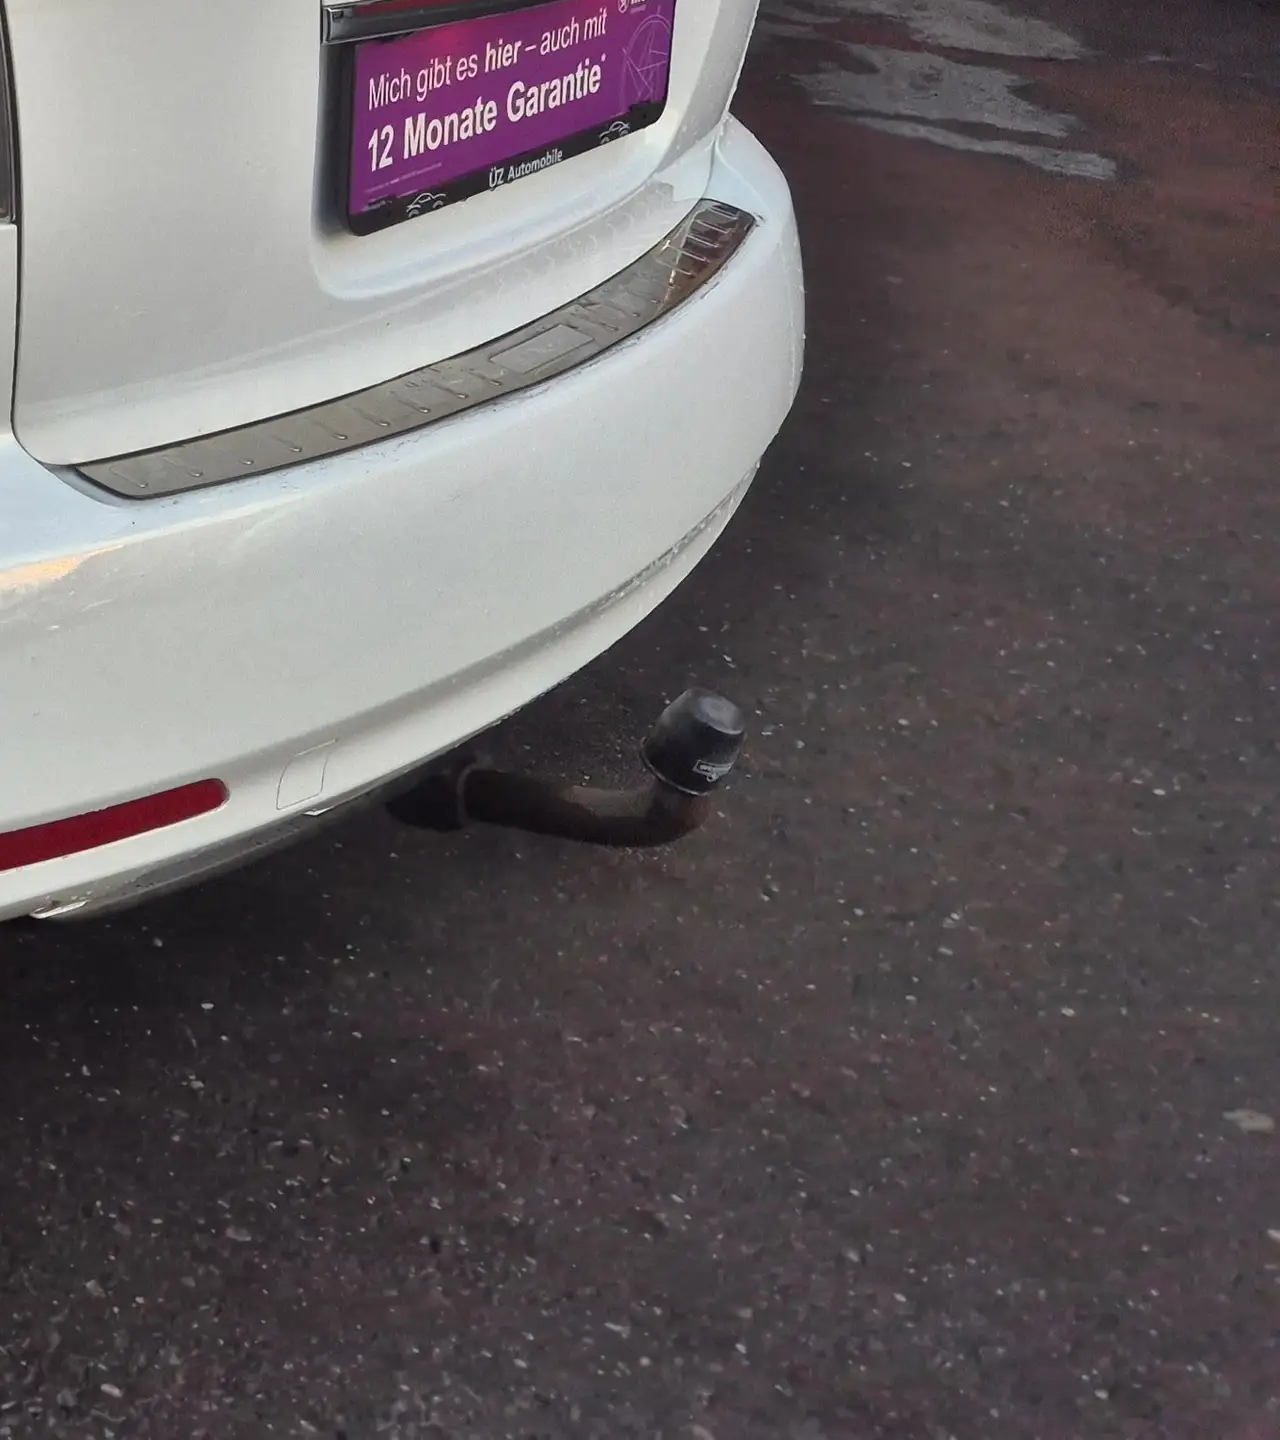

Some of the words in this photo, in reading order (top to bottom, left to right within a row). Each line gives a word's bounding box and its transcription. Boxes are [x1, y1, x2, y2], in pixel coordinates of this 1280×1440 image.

[368, 71, 411, 111] Mich
[416, 54, 452, 103] gibt
[456, 54, 478, 81] es
[484, 38, 522, 73] hier
[540, 17, 579, 56] auch
[583, 8, 608, 40] mit
[368, 124, 393, 172] 12
[403, 96, 497, 160] Monate
[489, 166, 505, 188] ÜZ
[508, 148, 563, 181] Automobile
